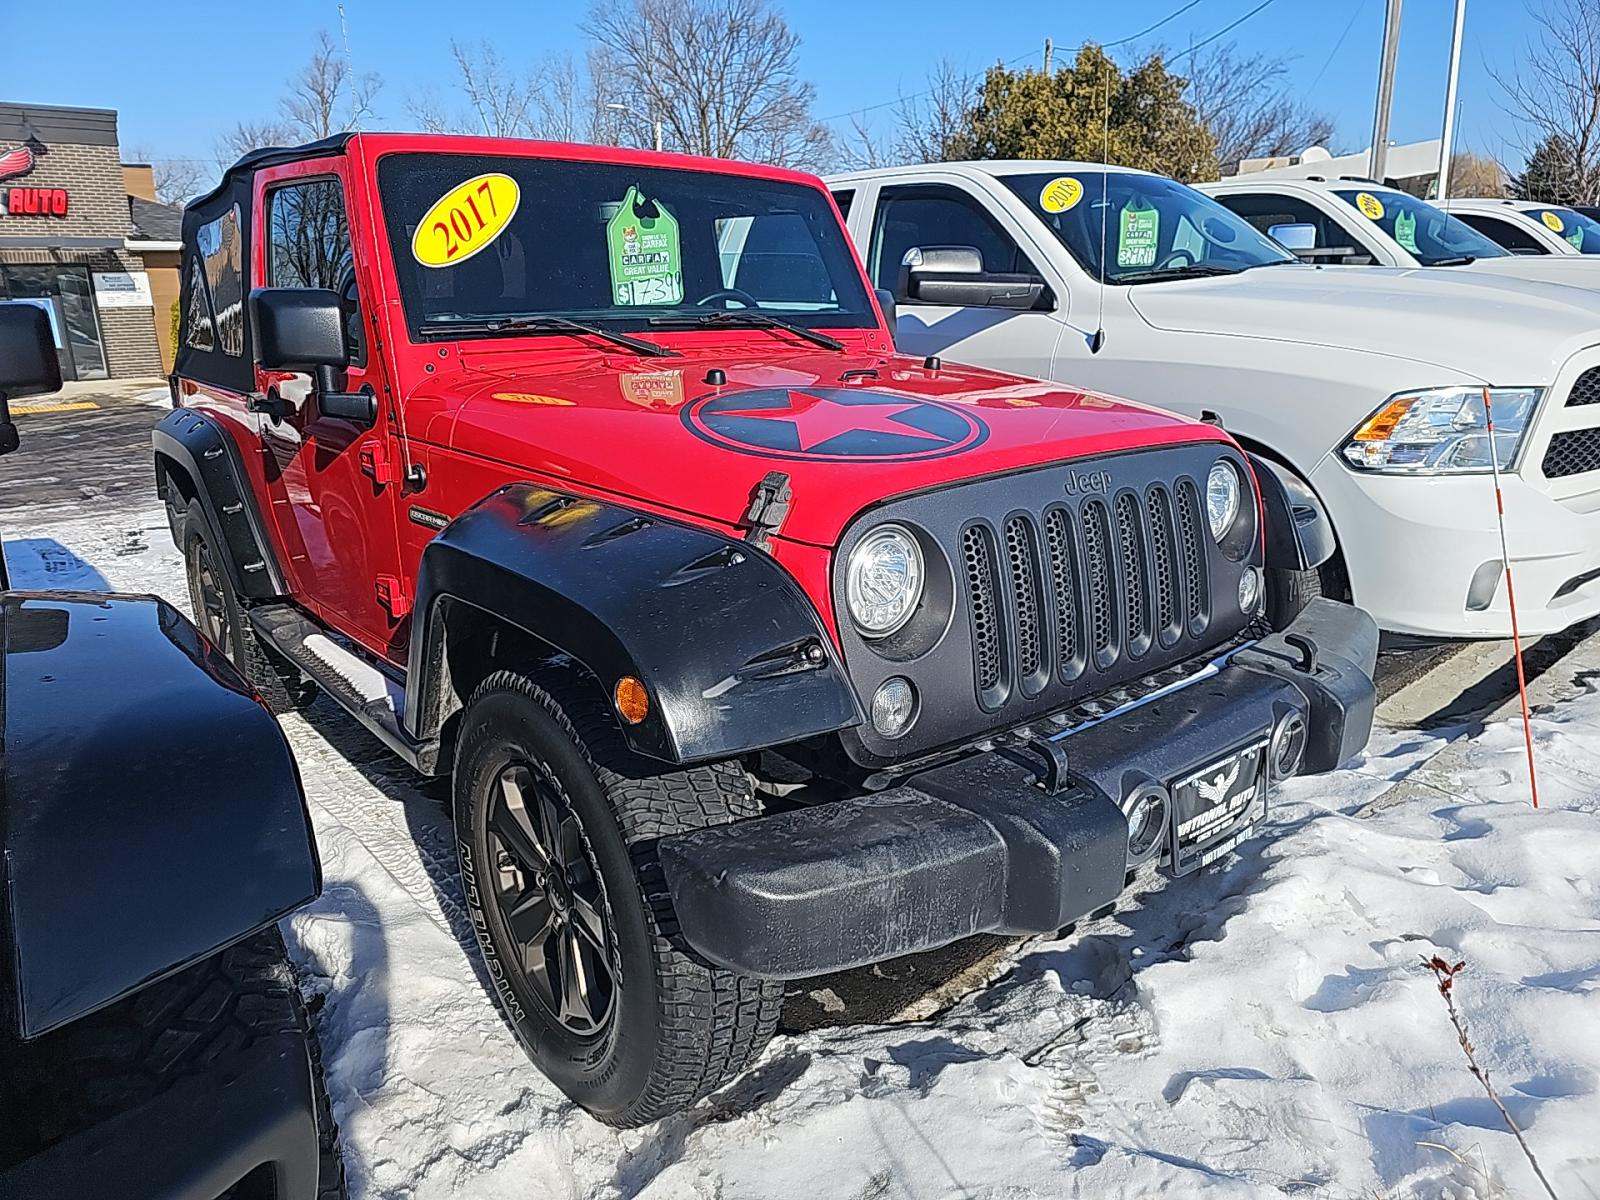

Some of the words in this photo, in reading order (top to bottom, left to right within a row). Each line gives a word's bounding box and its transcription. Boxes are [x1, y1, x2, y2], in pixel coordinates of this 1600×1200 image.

[9, 188, 67, 214] AUTO
[1048, 181, 1077, 207] 2018
[433, 181, 497, 258] 2017
[622, 252, 670, 266] CARFAX
[624, 266, 646, 276] GREAT
[648, 264, 670, 274] VALUE
[1064, 469, 1112, 496] Jeep
[1177, 801, 1228, 838] NATIONAL
[1229, 785, 1256, 811] AUTO
[457, 838, 526, 1023] MICHELIN
